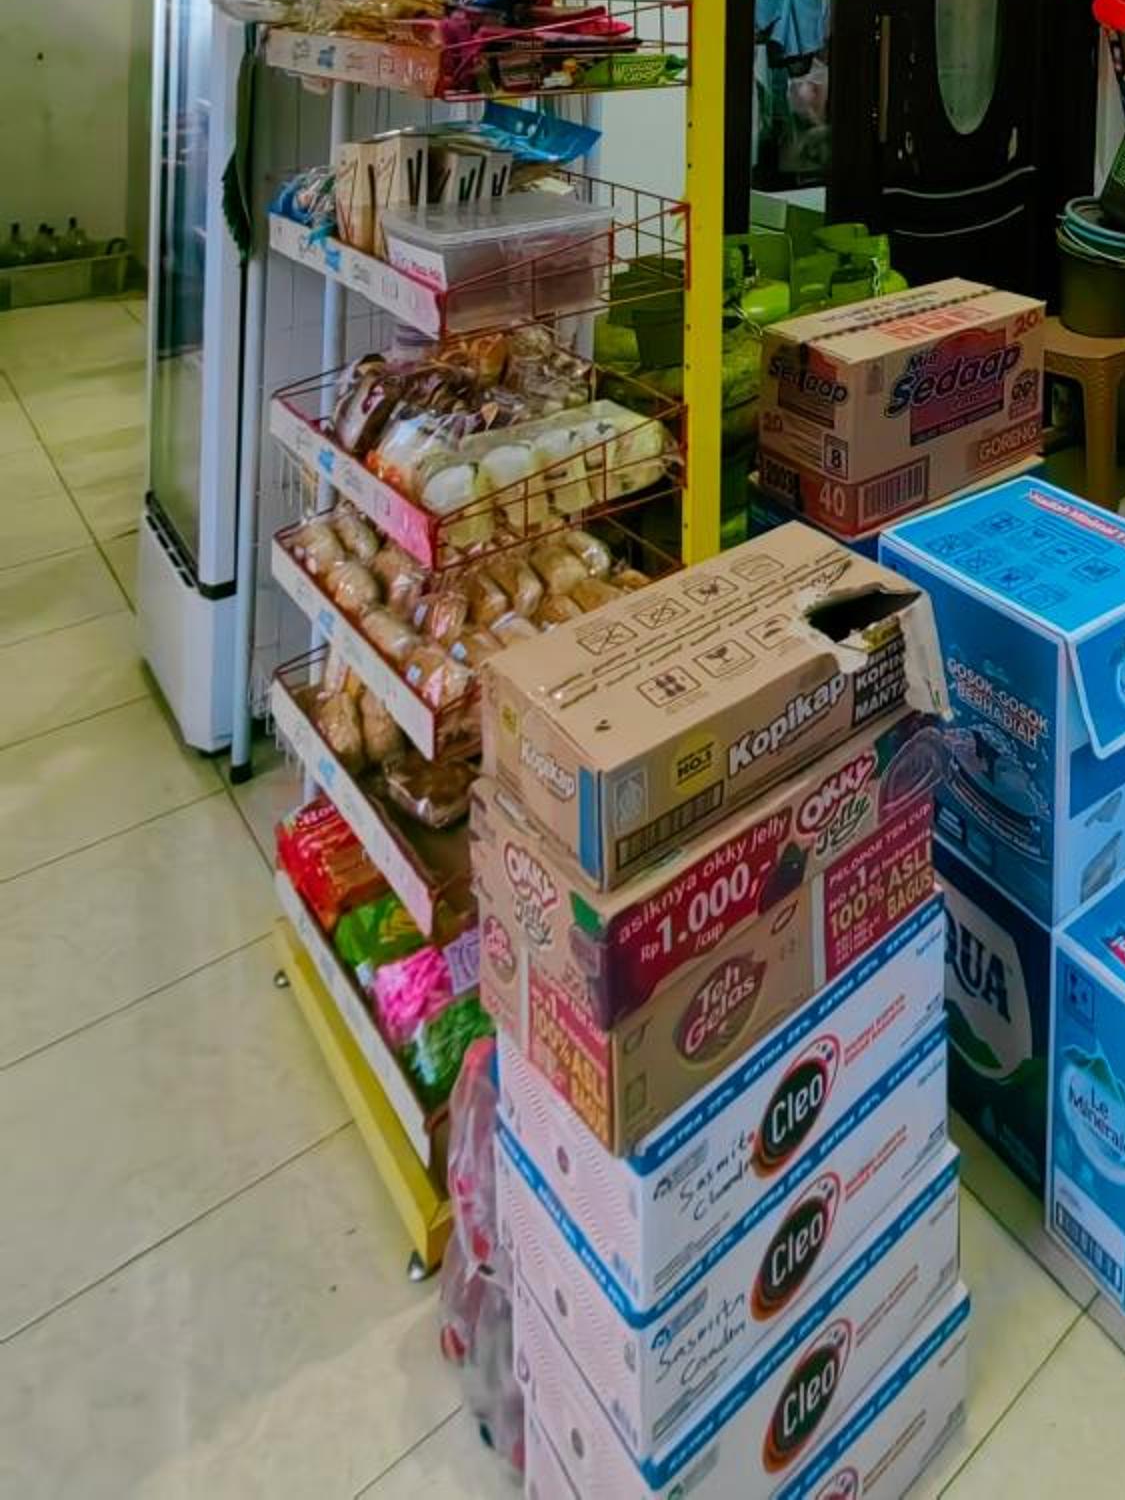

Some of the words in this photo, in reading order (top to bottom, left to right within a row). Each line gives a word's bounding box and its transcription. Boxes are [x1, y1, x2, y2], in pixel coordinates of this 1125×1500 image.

[883, 343, 1021, 418] Sedaap
[830, 450, 842, 469] 8
[978, 421, 1038, 460] GORENG
[819, 484, 846, 518] 40
[728, 673, 846, 777] Kopikap
[948, 658, 1048, 732] GOSOK-GOSOK
[957, 682, 1037, 748] BERHADIAH
[520, 739, 576, 797] Kopikap
[799, 755, 874, 831] OKKY
[618, 871, 698, 945] asiknya
[703, 838, 748, 878] okky
[750, 814, 787, 854] jelly
[831, 883, 886, 935] 100%
[887, 870, 934, 920] BAGUS
[641, 942, 660, 964] Rp
[685, 974, 757, 1054] Gelas
[698, 963, 740, 1013] Teh
[771, 1074, 824, 1145] Cleo
[1091, 1090, 1109, 1115] Le
[771, 1216, 824, 1288] Cleo
[782, 1361, 835, 1437] Cleo
